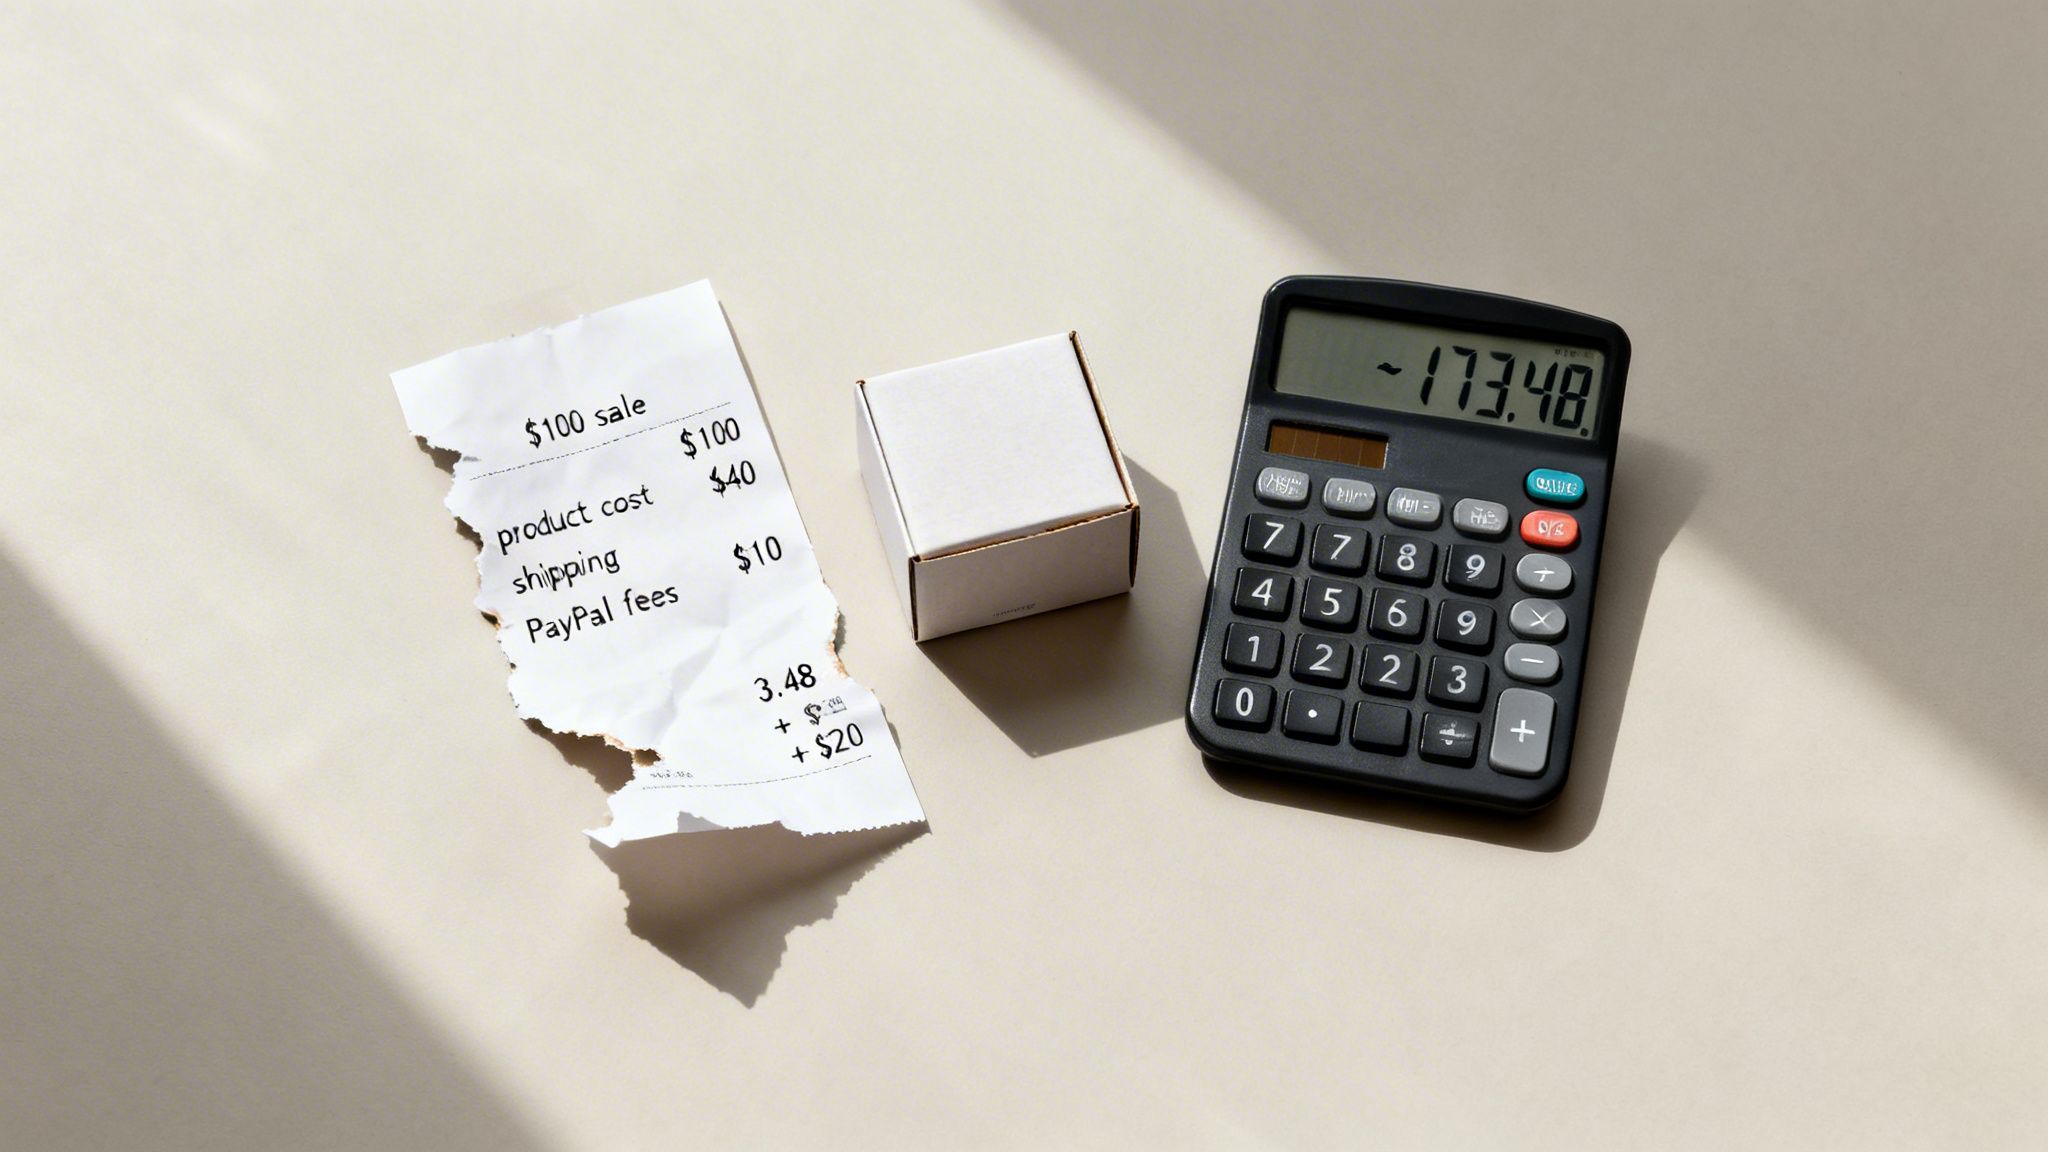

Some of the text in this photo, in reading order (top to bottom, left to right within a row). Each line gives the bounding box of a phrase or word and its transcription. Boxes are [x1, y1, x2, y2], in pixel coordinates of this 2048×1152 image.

[525, 394, 647, 449] $100 sale
[680, 417, 741, 460] $100
[497, 460, 756, 556] product cost $40
[1263, 521, 1285, 549] 7
[1331, 534, 1352, 560] 7
[733, 536, 783, 575] $10
[1397, 543, 1417, 571] 8
[1466, 554, 1486, 580] 9
[512, 549, 621, 595] shipping
[1251, 578, 1273, 606] 4
[1320, 588, 1343, 616] 5
[526, 585, 680, 644] PayPal fees
[1387, 598, 1408, 628] 6
[1457, 610, 1477, 636] 9
[1247, 635, 1260, 662] 1
[1309, 644, 1332, 672] 2
[754, 663, 817, 703] 3.48
[1378, 654, 1401, 685] 2
[1447, 665, 1467, 694] 3
[1235, 687, 1254, 717] 0
[815, 722, 864, 760] $20
